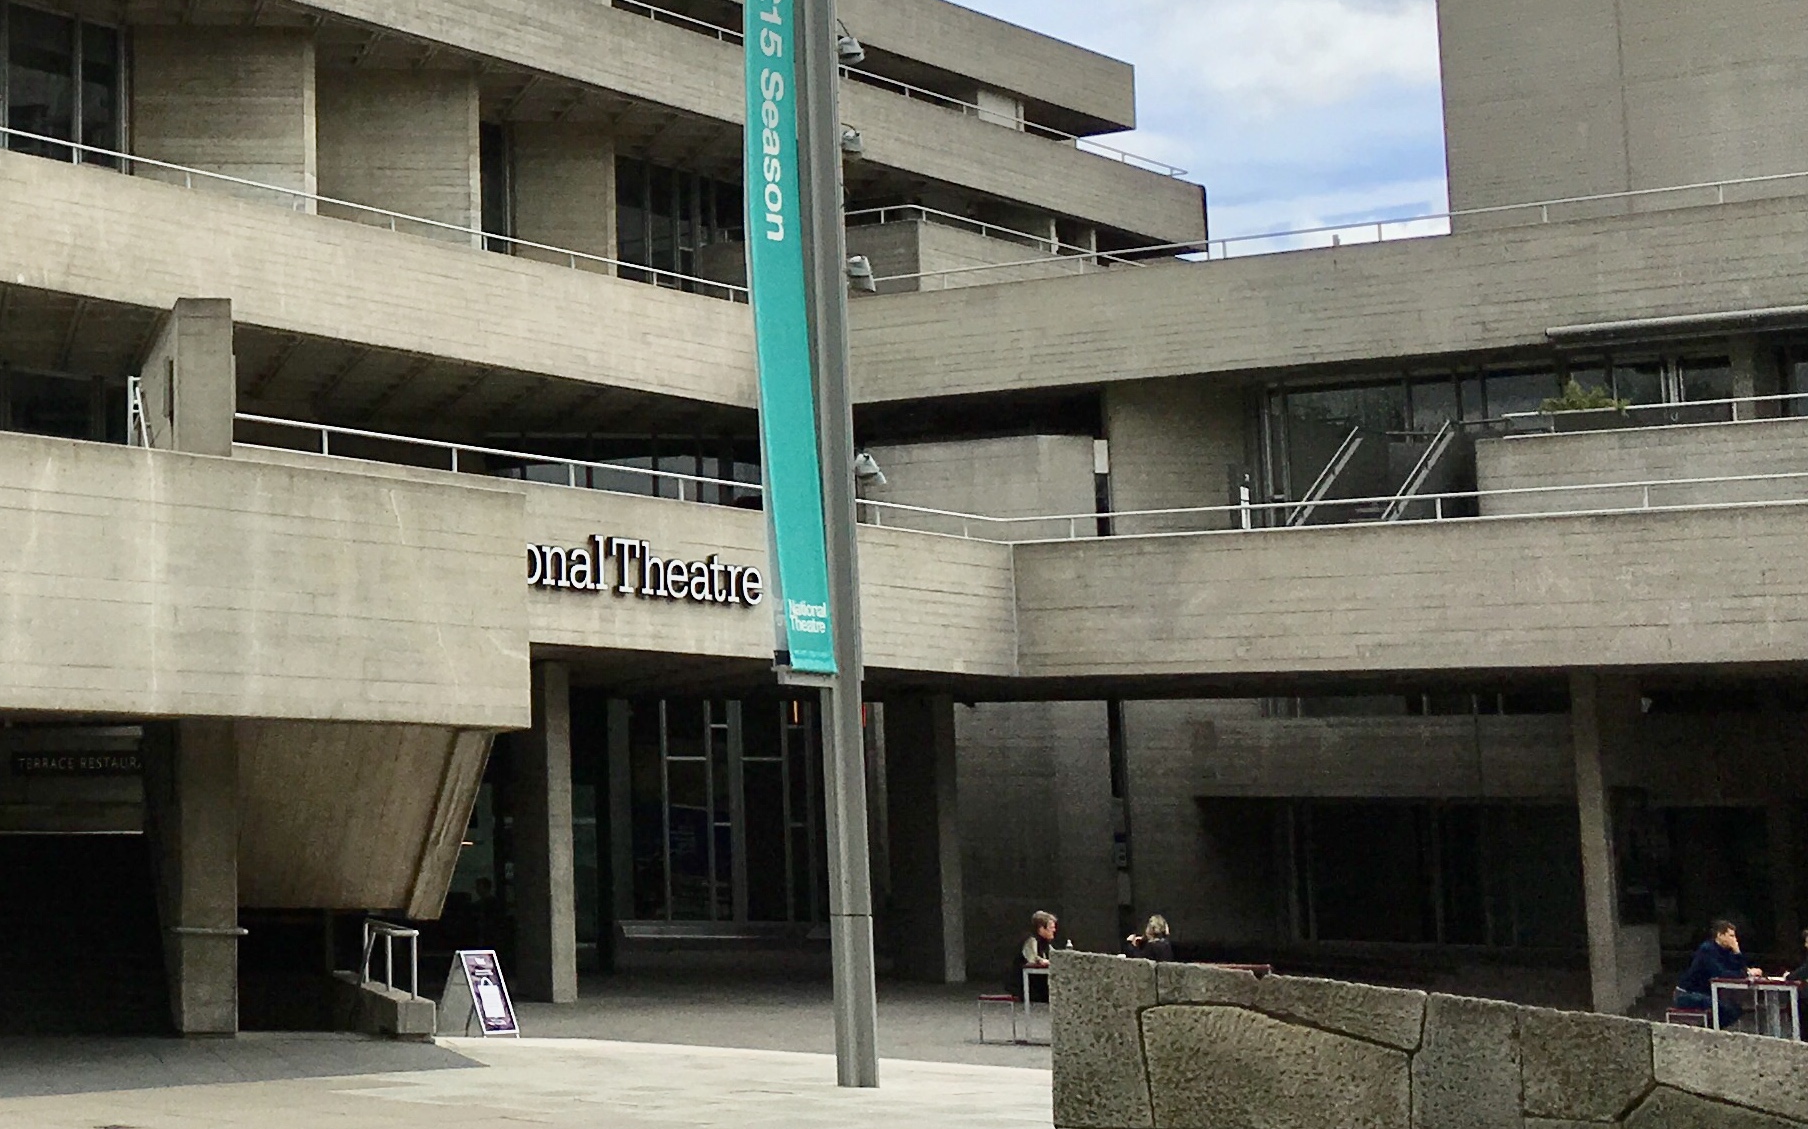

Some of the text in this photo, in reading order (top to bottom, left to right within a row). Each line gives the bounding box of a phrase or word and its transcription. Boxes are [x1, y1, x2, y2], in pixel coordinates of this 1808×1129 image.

[761, 68, 785, 241] Season
[612, 537, 764, 605] Theatre
[788, 598, 826, 618] National
[790, 615, 826, 633] Theatre
[17, 756, 74, 770] TERRACE
